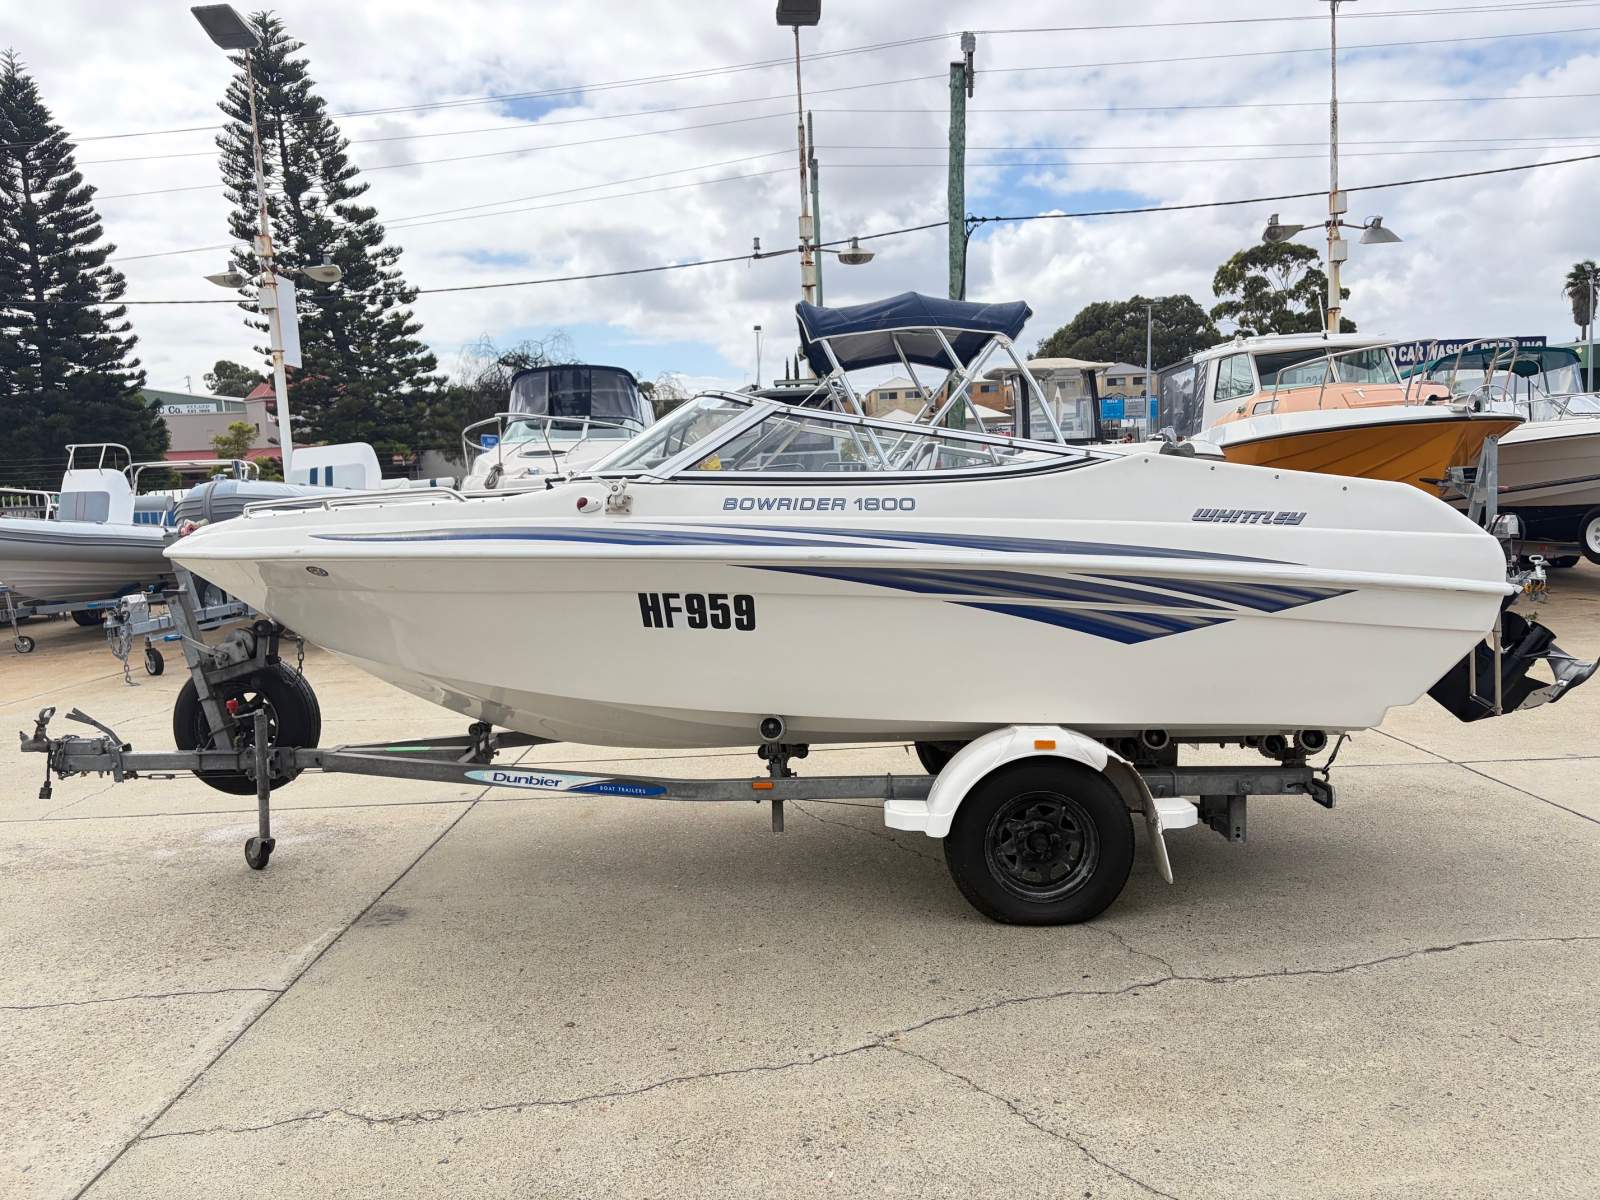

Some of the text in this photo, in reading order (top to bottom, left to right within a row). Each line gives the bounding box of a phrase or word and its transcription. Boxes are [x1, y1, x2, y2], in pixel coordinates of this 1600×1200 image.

[1399, 346, 1424, 362] CAR
[722, 497, 916, 511] BOWRIDER 1800
[1191, 508, 1308, 526] WHITTLEY
[637, 592, 756, 632] HF959
[492, 772, 563, 788] Dunbier
[618, 786, 647, 795] TRAILERS
